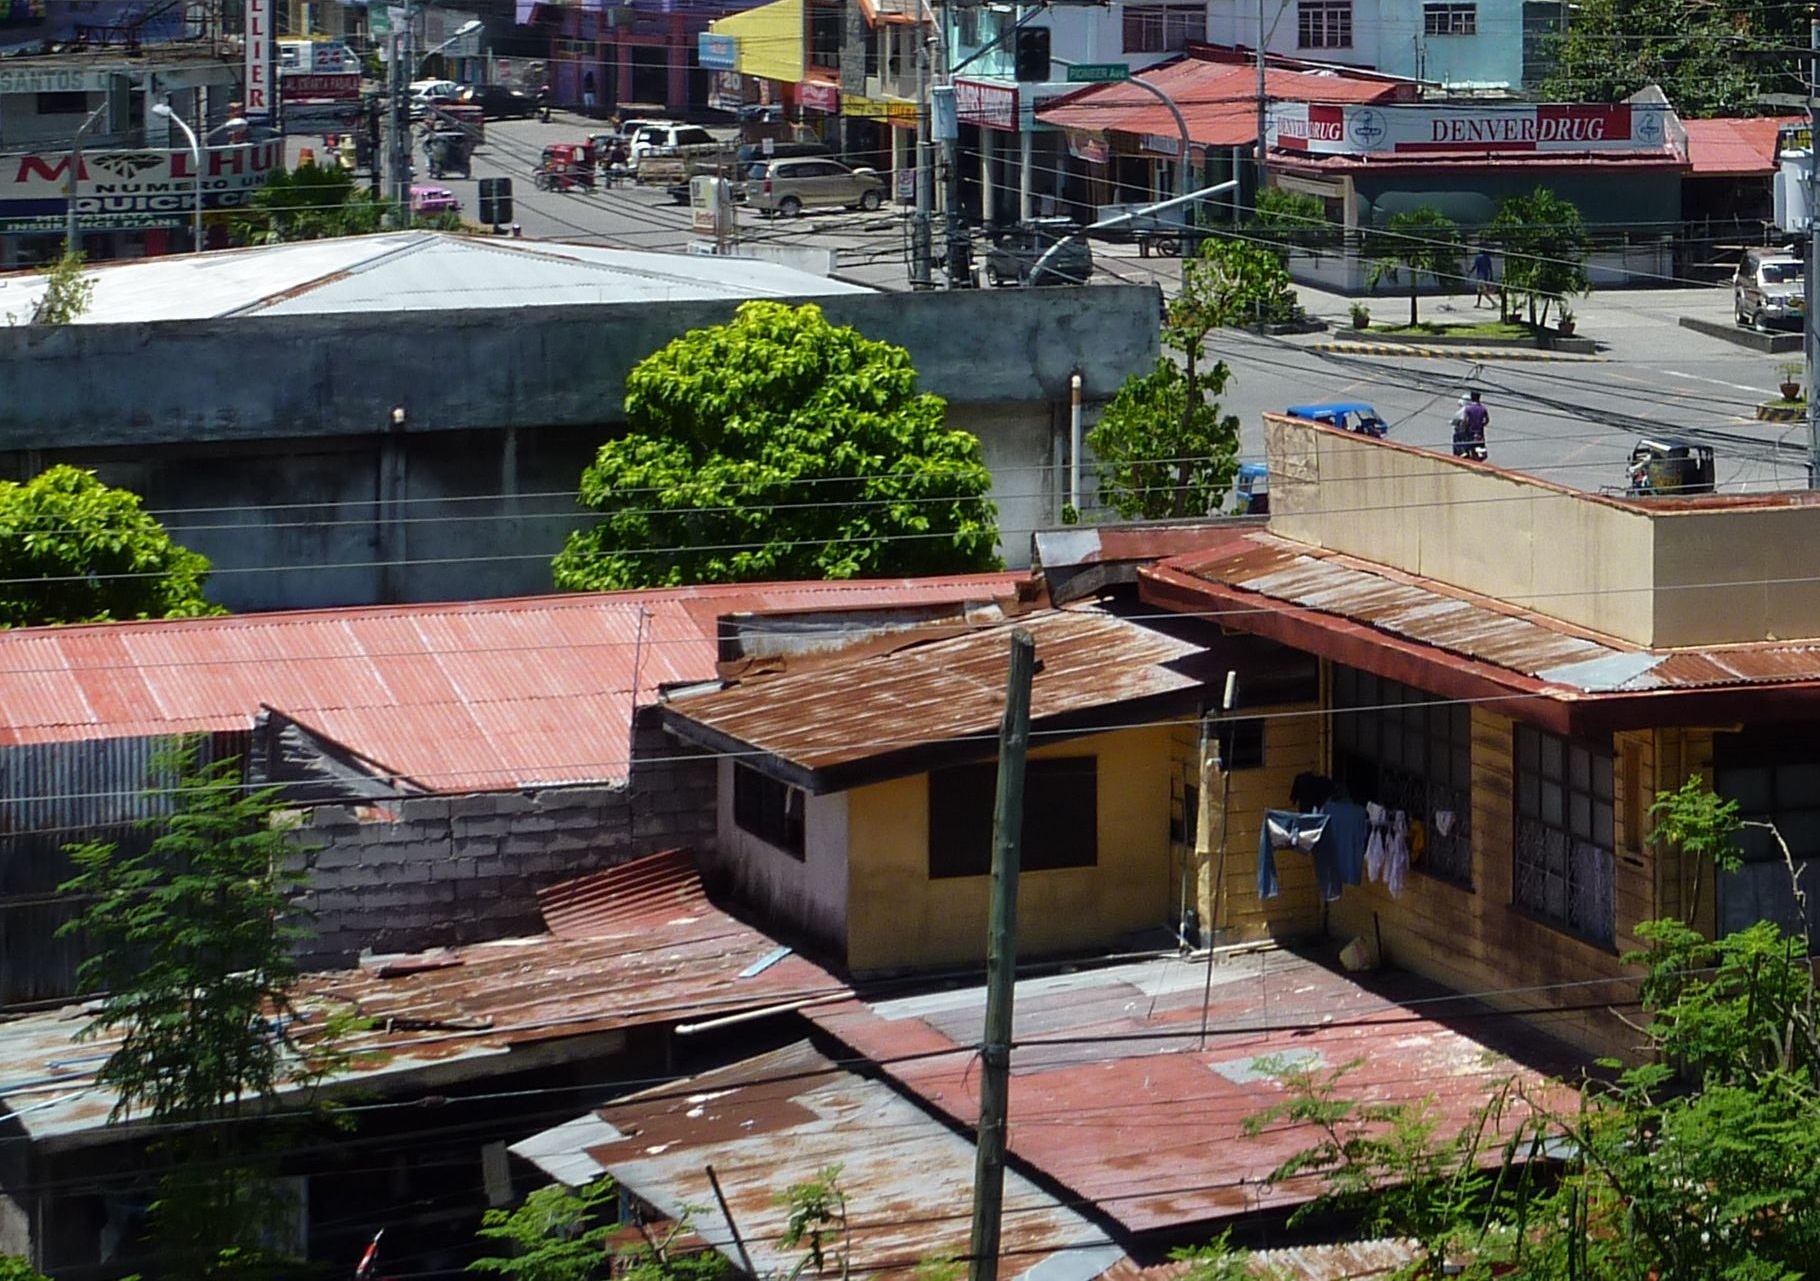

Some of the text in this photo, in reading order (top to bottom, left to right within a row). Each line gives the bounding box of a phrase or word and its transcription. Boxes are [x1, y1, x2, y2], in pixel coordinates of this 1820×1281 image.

[317, 50, 341, 65] 24
[1278, 117, 1342, 140] DENVER DRUG
[14, 156, 91, 183] M
[96, 179, 228, 194] NUMERO
[76, 194, 207, 214] QUICK
[123, 218, 181, 228] PLANS
